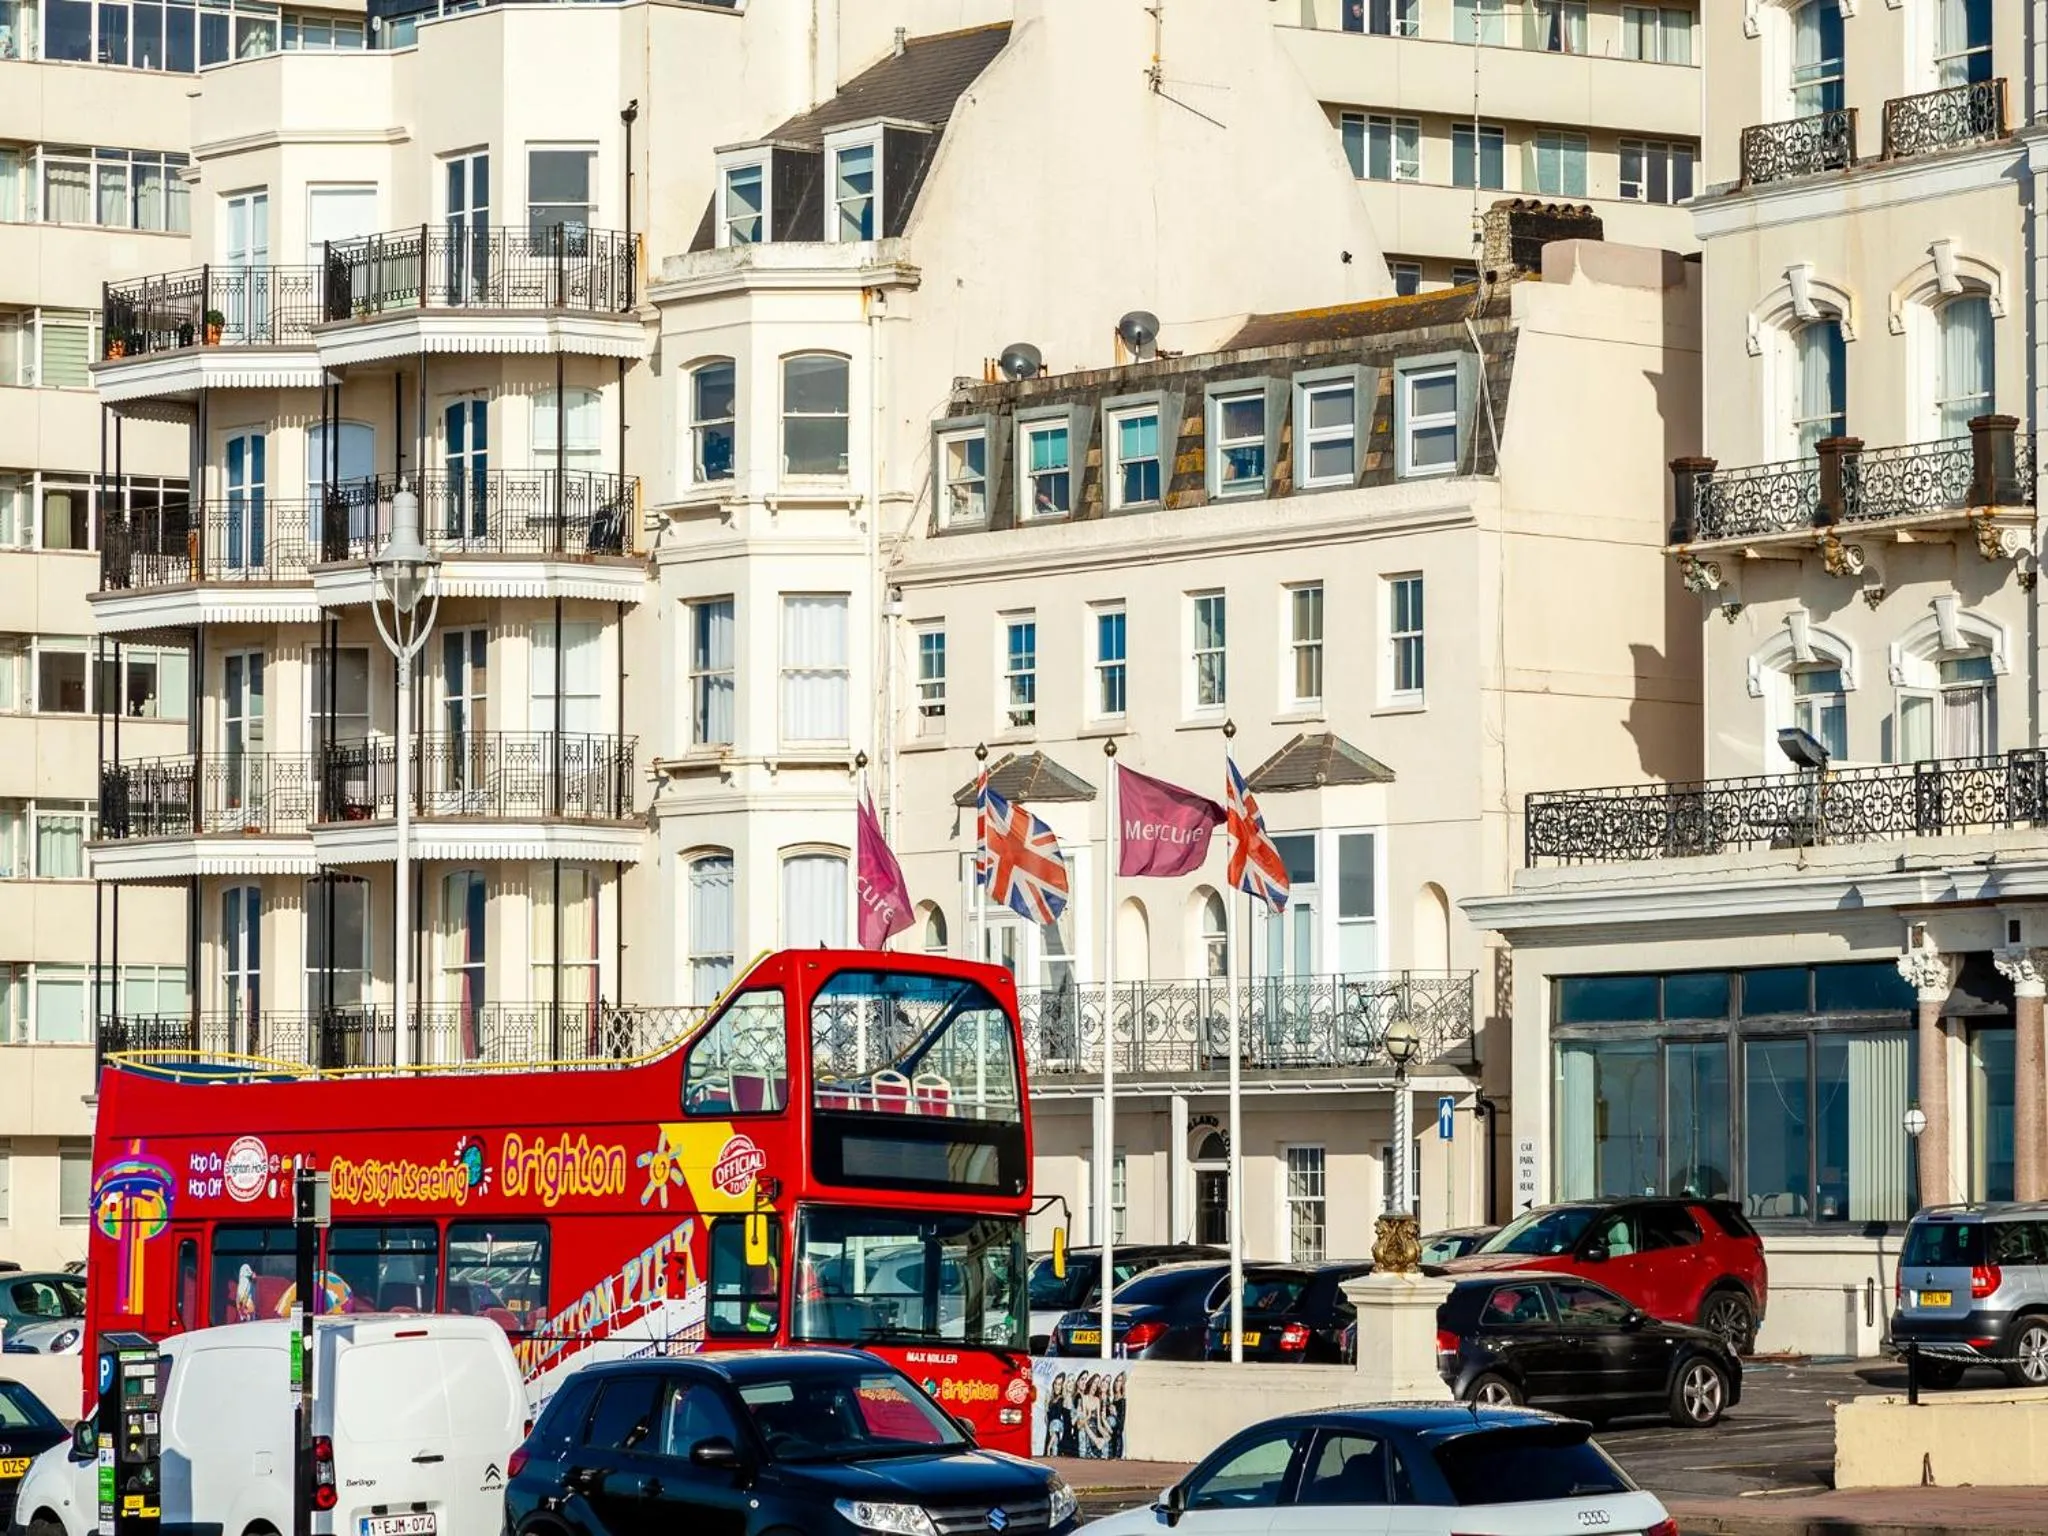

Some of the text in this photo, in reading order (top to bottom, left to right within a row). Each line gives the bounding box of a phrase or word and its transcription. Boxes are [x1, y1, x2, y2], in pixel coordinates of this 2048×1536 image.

[1125, 820, 1204, 844] Mercure
[1520, 1142, 1533, 1152] CAR
[190, 1151, 222, 1173] Hop On
[502, 1133, 626, 1207] Brighton
[715, 1152, 762, 1185] OFFICIAL
[1519, 1156, 1534, 1165] PARK
[330, 1155, 468, 1206] CitySightseeing
[730, 1175, 751, 1193] TOUR
[1522, 1169, 1532, 1178] TO
[189, 1178, 207, 1199] Hop
[208, 1177, 223, 1197] Off
[621, 1218, 699, 1313] PIER
[906, 1351, 957, 1364] MAX MILLER
[100, 1358, 110, 1387] P
[942, 1378, 999, 1403] Brighton
